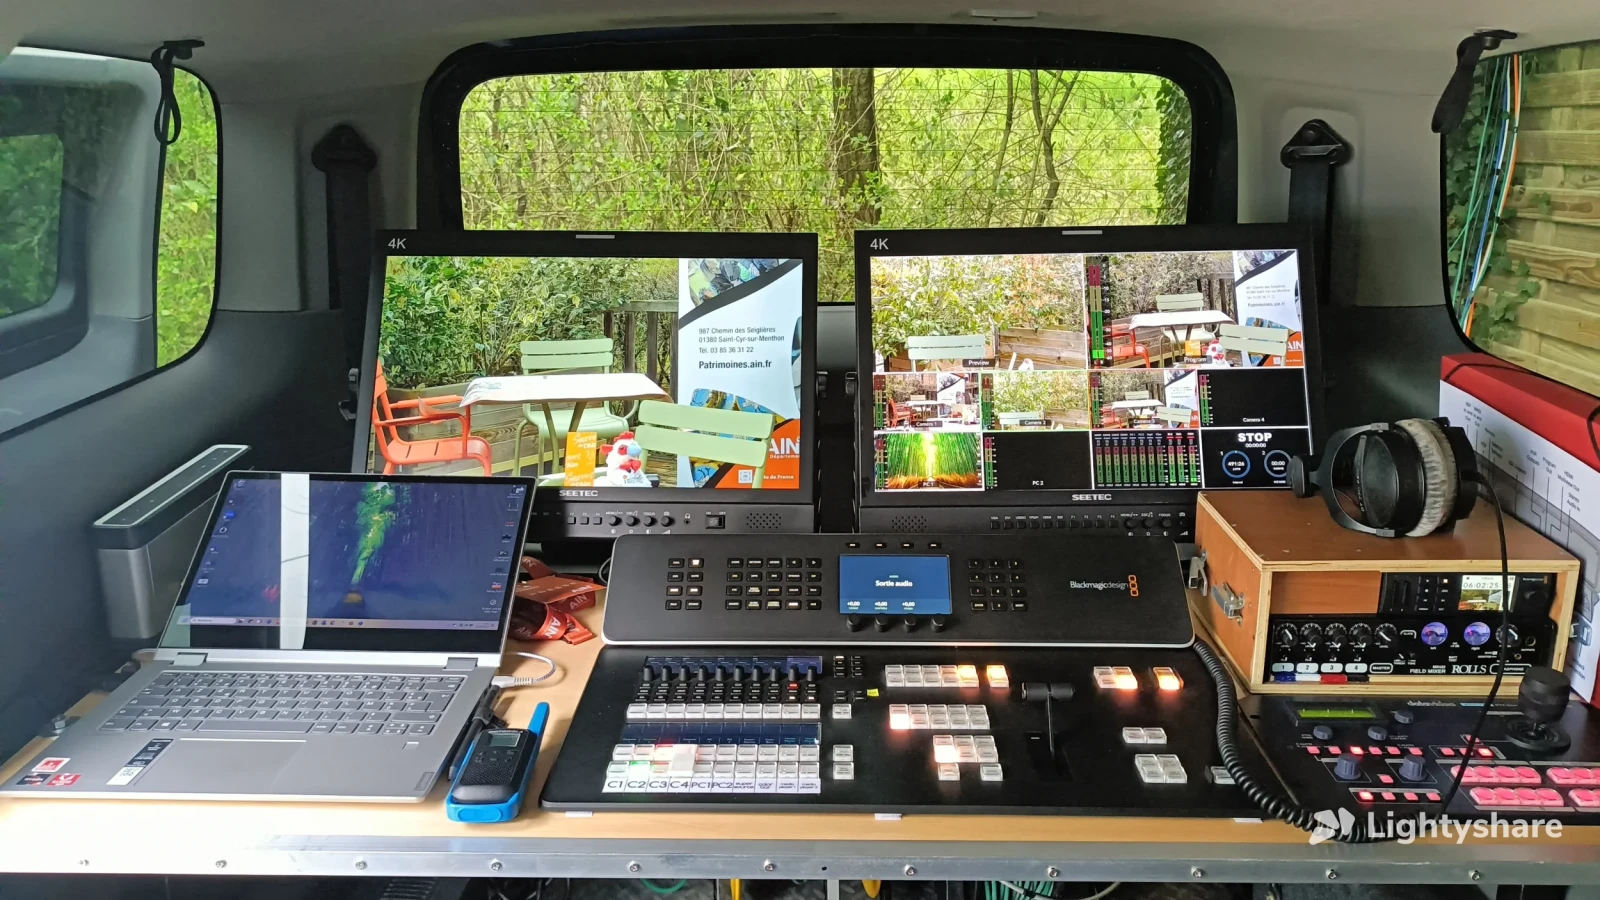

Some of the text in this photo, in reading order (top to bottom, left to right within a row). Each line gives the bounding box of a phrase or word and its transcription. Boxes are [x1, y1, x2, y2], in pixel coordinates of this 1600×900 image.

[388, 238, 406, 249] 4K
[870, 238, 889, 250] 4K
[718, 335, 785, 343] Saint-Cyr-sur-Menthon
[698, 360, 772, 370] Patrimoines.ain.fr
[1238, 432, 1272, 442] STOP
[769, 438, 800, 454] AIN
[1542, 456, 1556, 469] Program
[1564, 470, 1574, 480] HDMI
[1558, 474, 1573, 488] Multiview
[1568, 492, 1580, 503] Stereo
[1566, 500, 1576, 509] Audio
[570, 594, 588, 610] AIN
[544, 616, 562, 639] AIN
[1452, 665, 1487, 674] ROLLS
